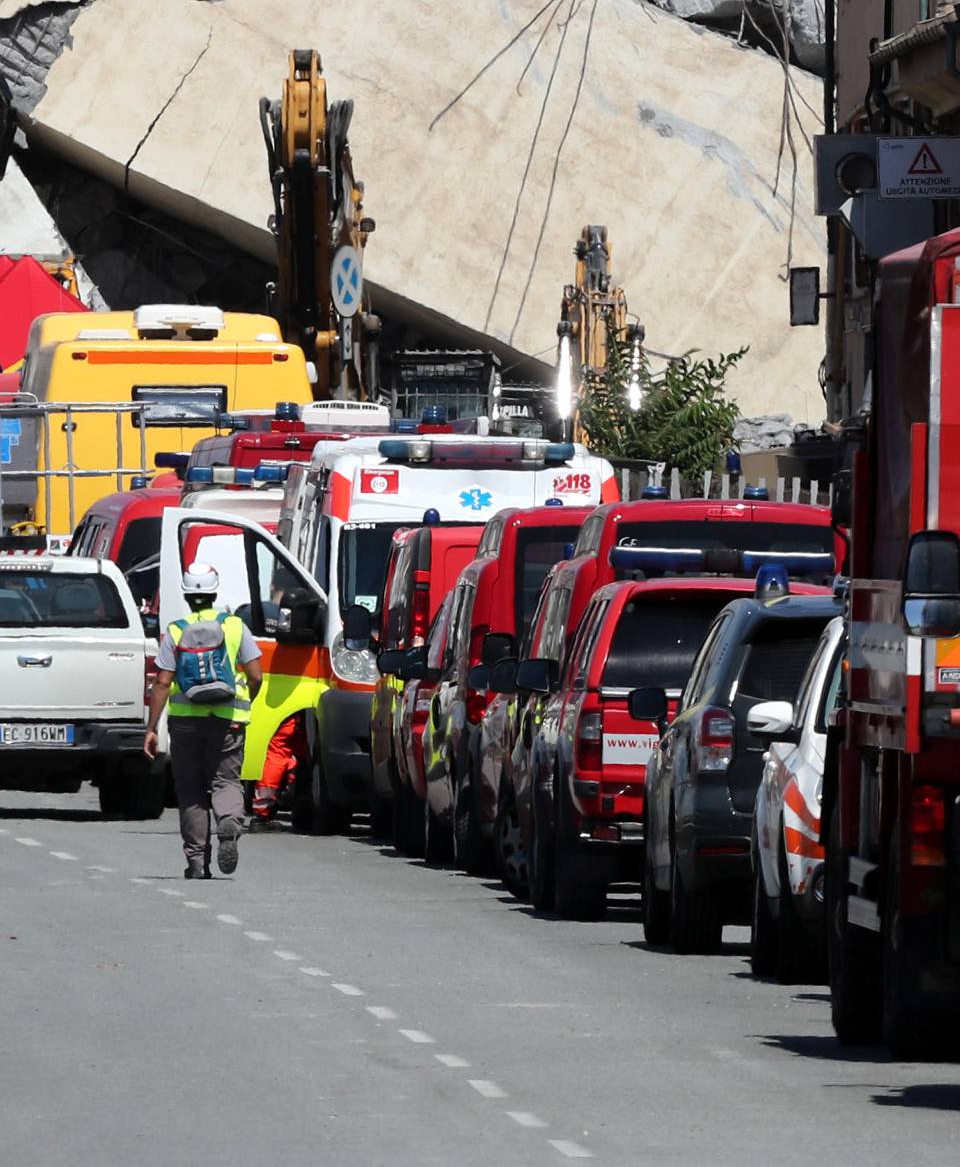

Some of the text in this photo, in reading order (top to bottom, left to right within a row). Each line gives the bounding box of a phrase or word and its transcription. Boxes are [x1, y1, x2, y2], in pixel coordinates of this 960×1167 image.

[899, 177, 952, 186] ATTENZIONE
[886, 187, 917, 195] USCITA
[566, 474, 591, 489] 118
[3, 726, 65, 741] EC 916WM
